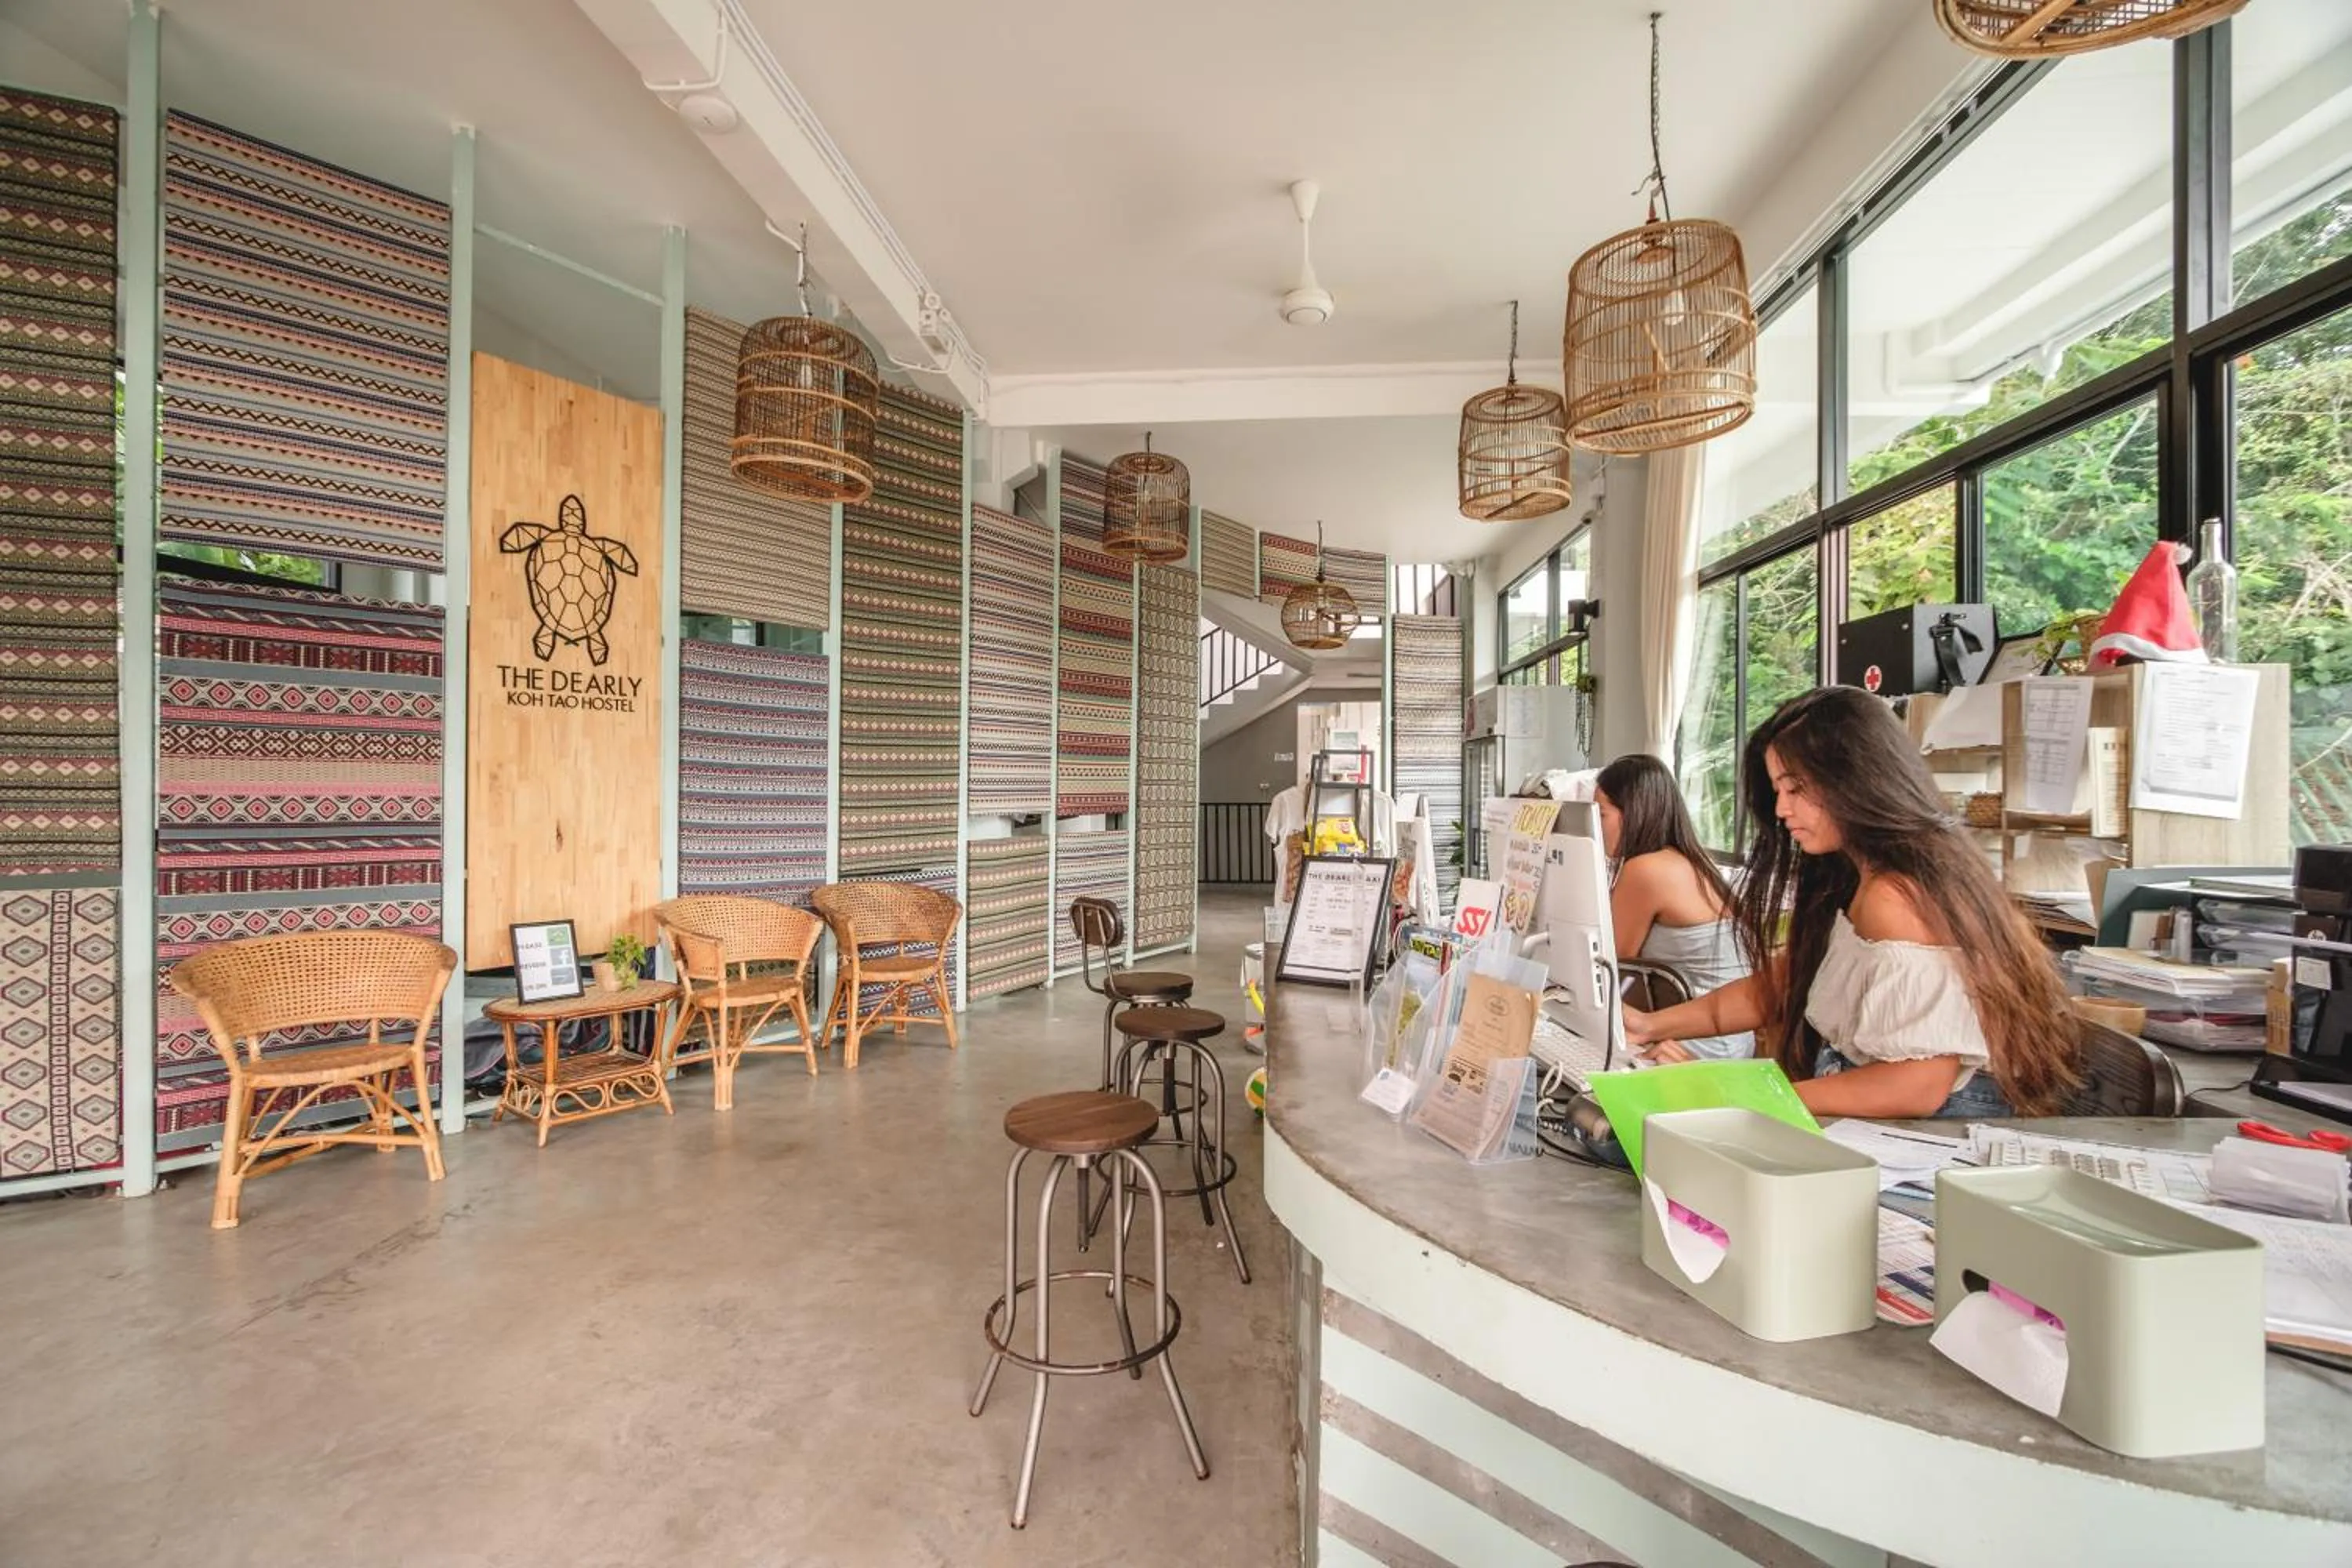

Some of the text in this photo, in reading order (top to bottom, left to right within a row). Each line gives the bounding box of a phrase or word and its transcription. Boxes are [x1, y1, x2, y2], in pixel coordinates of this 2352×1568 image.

[497, 665, 642, 697] THE DEARLY
[507, 691, 635, 713] KOH TAO HOSTEL
[1325, 873, 1356, 882] DEARL
[1457, 906, 1491, 936] SSI
